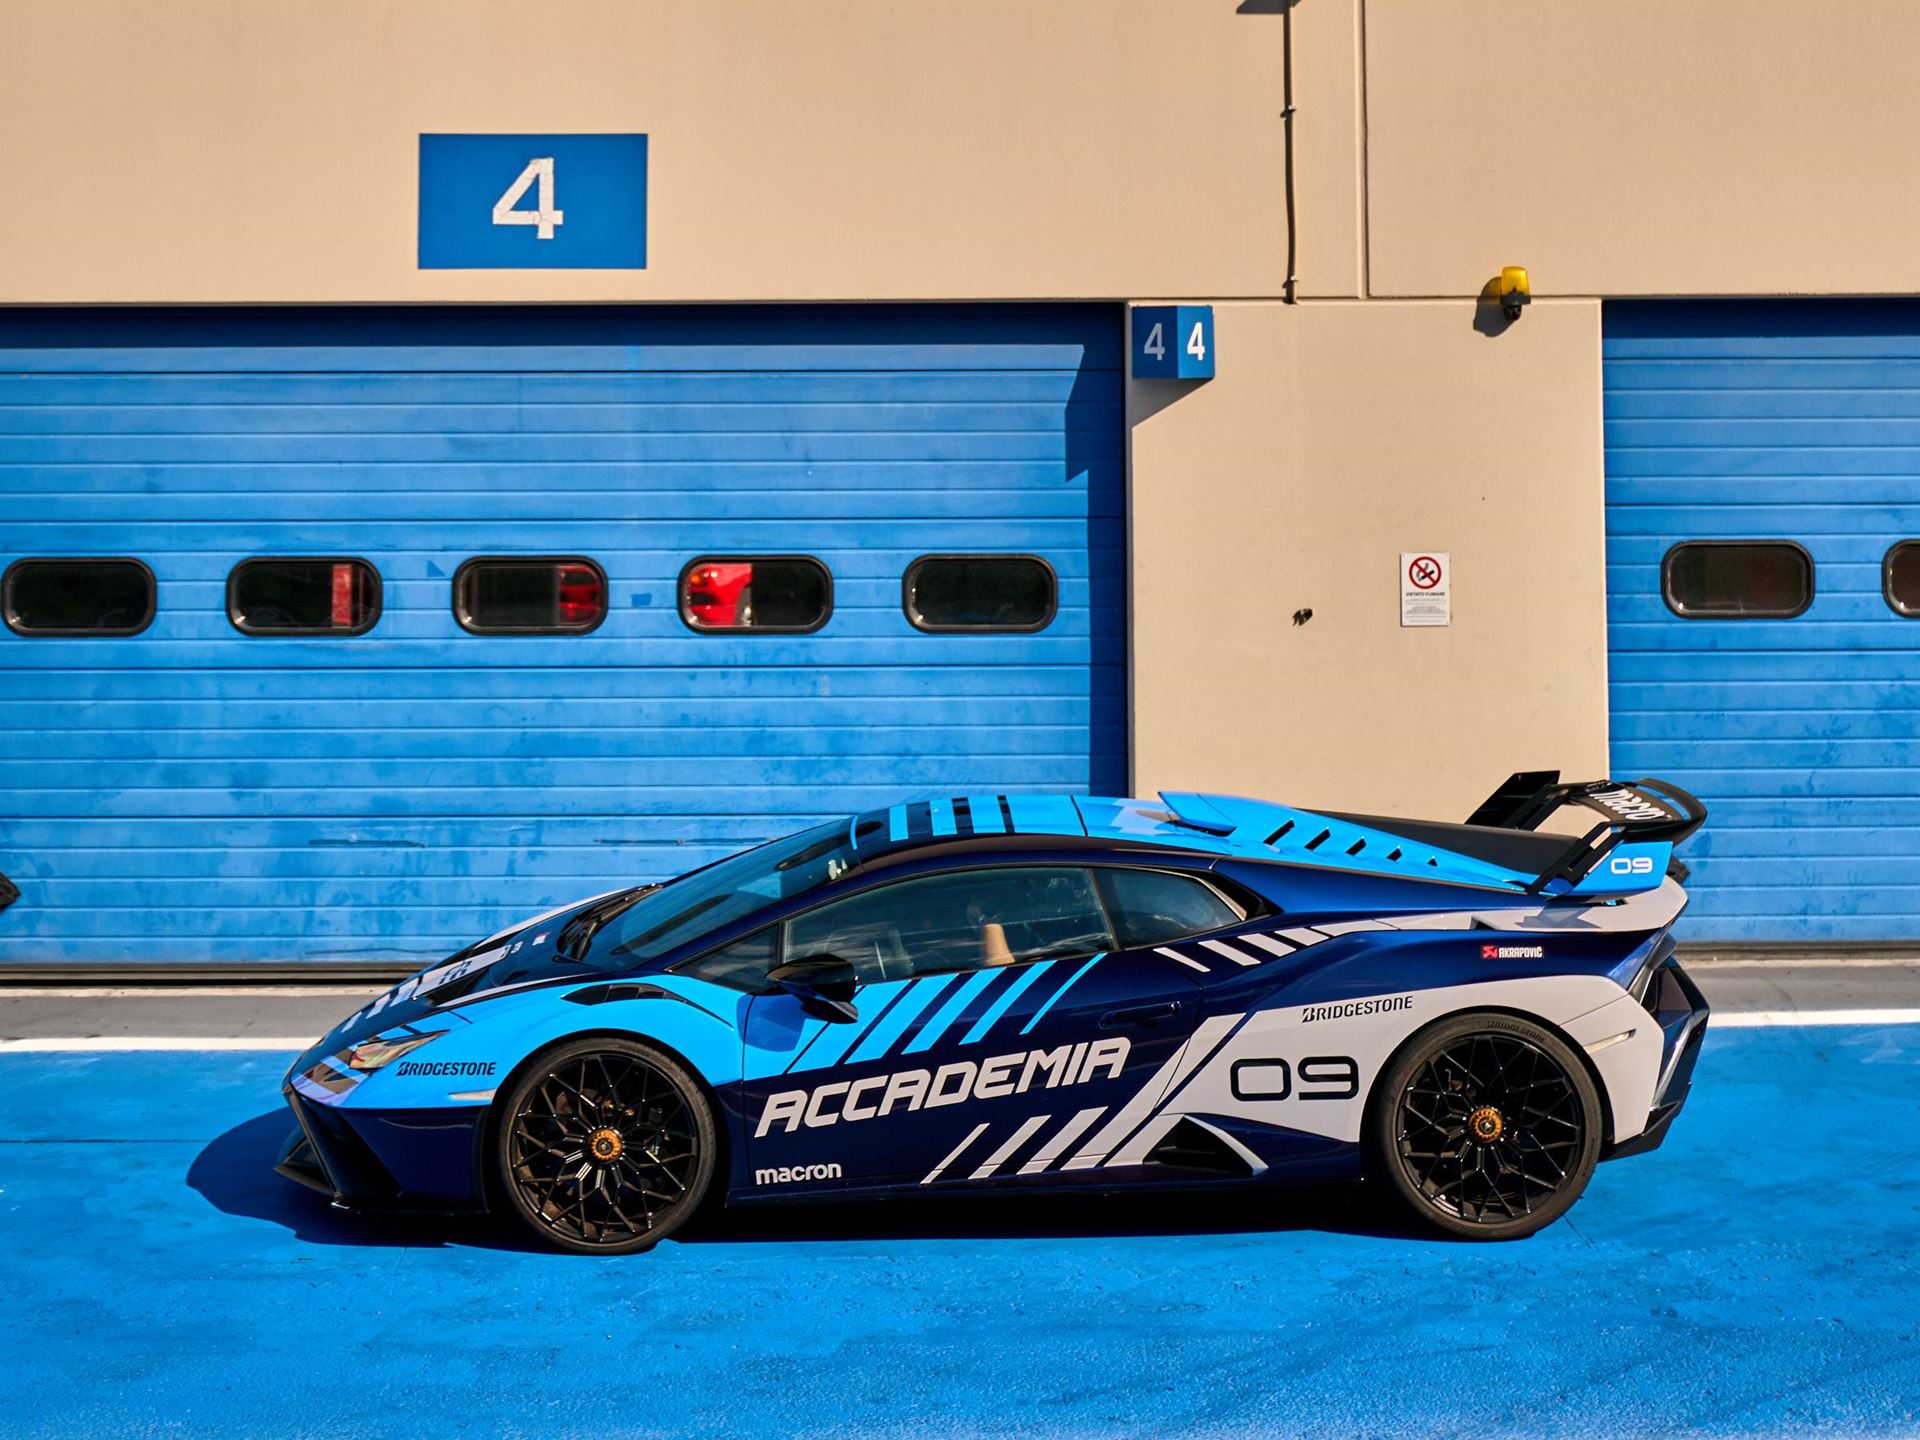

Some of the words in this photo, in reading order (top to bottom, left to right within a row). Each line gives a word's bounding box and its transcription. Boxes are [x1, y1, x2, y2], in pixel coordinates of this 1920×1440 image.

[492, 157, 564, 239] 4
[1143, 323, 1165, 361] 4
[1187, 322, 1206, 361] 4
[1610, 857, 1653, 875] 09
[1302, 996, 1414, 1024] BRIDGESTONE
[396, 1061, 497, 1077] BRIDGESTONE
[754, 1036, 1132, 1139] ACCADEMIA
[1230, 1055, 1360, 1102] 09
[755, 1162, 842, 1186] macron
